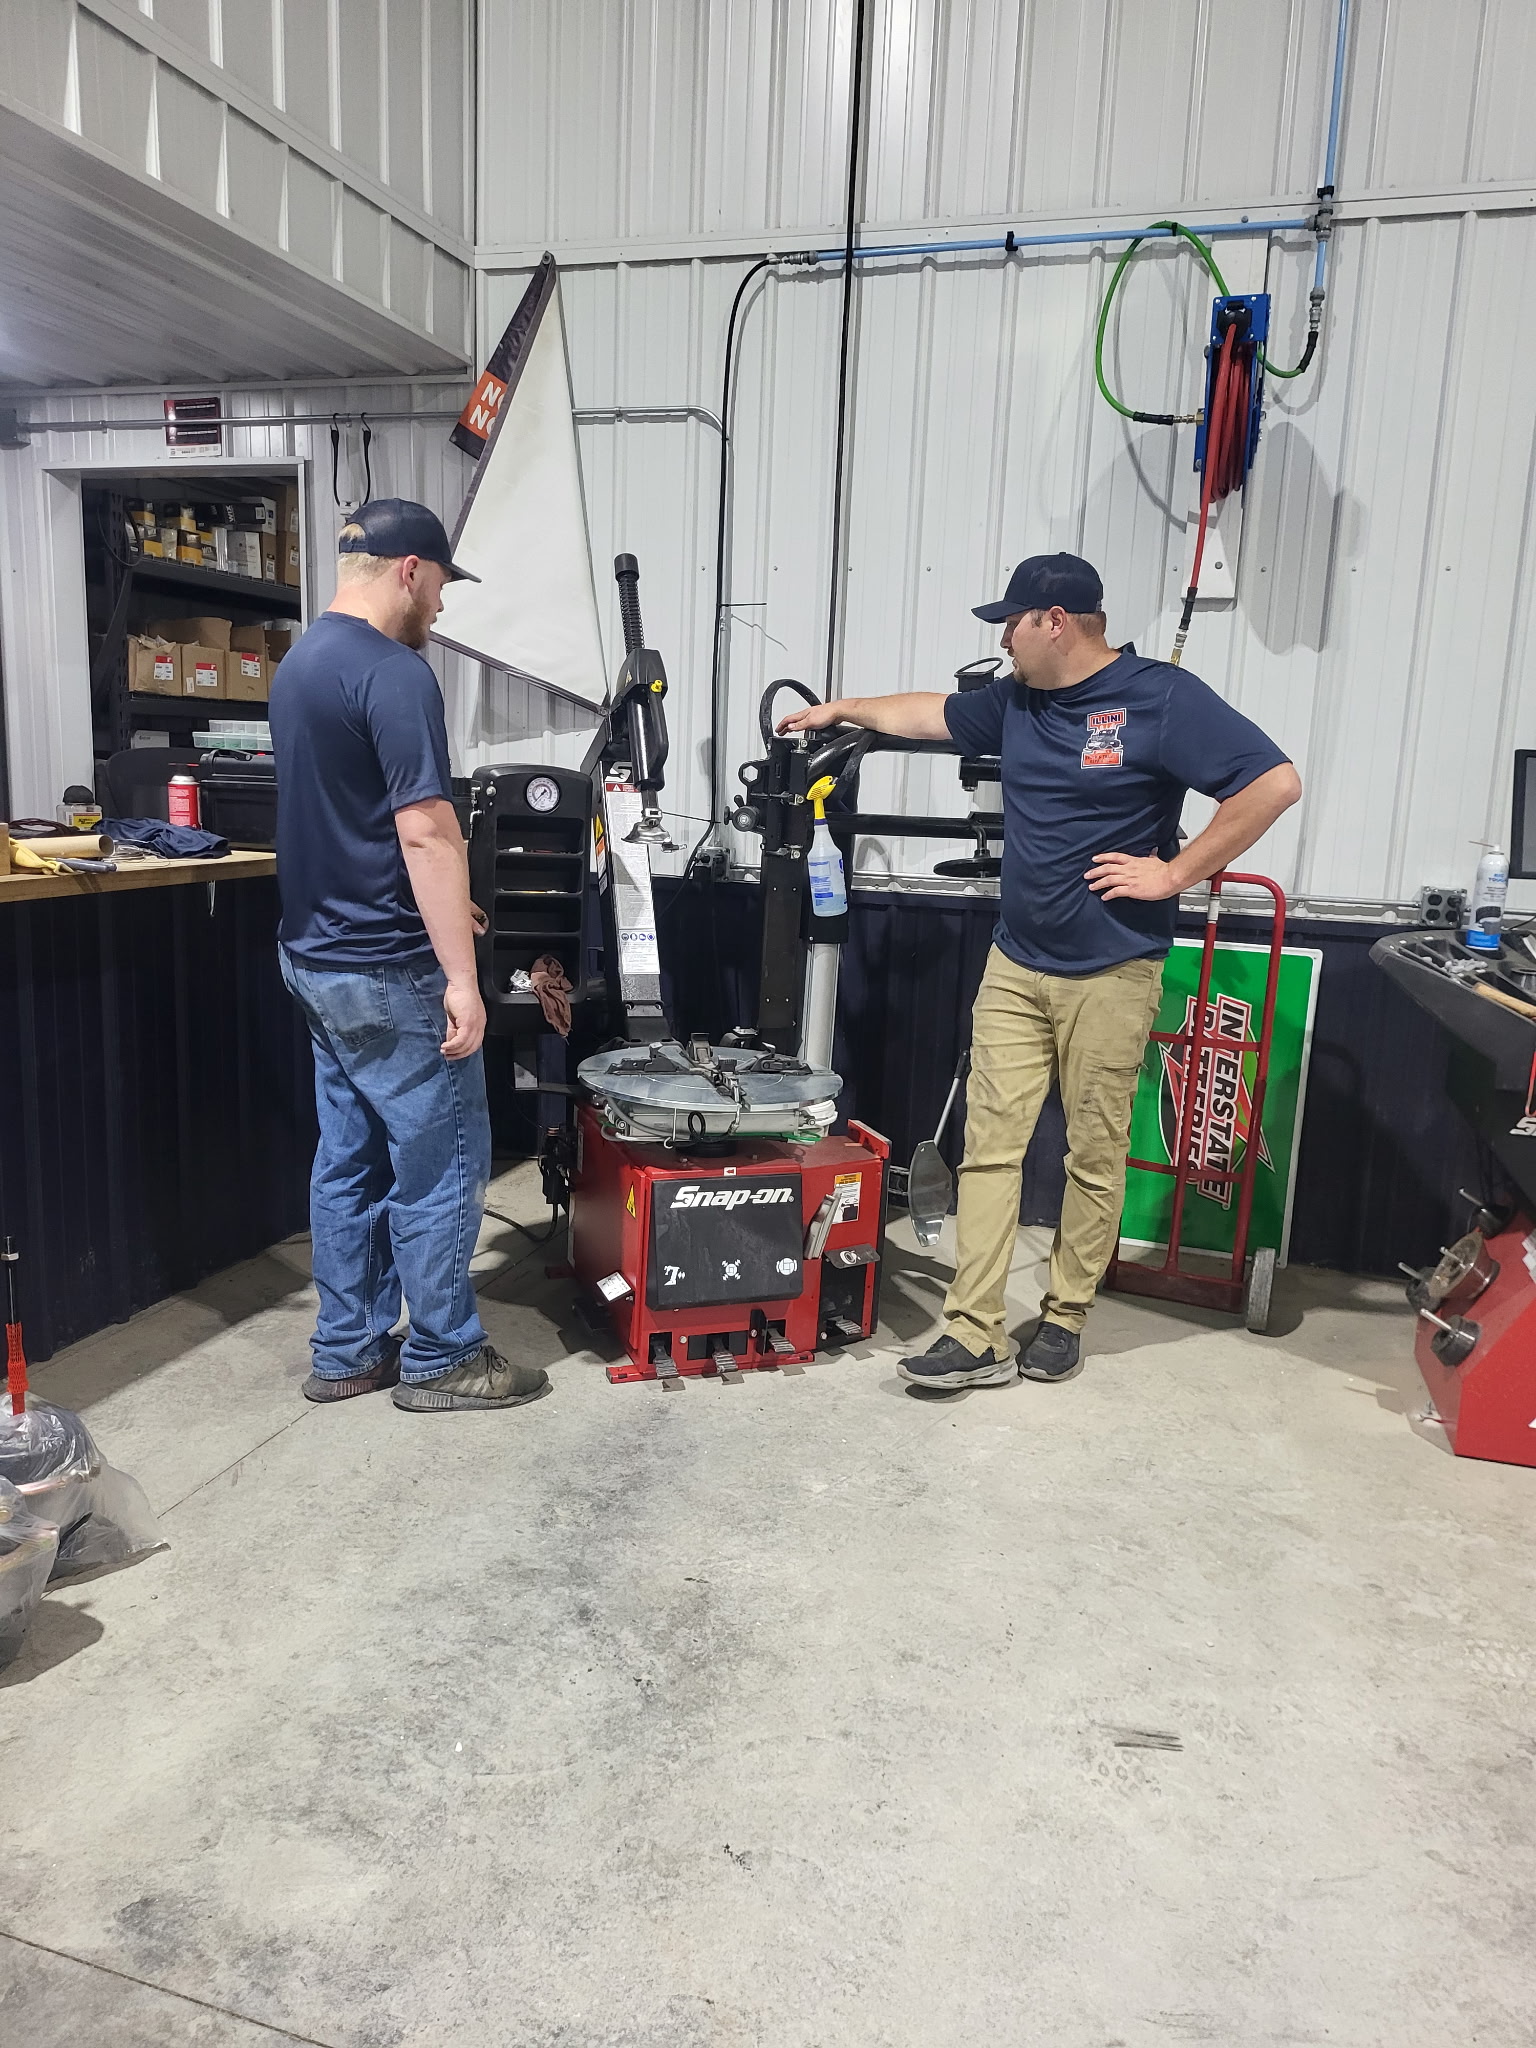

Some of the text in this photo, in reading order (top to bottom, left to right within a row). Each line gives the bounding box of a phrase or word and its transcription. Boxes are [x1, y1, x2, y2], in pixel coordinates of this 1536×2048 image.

[1093, 713, 1121, 725] ILLINI
[1177, 1003, 1216, 1180] BTTERIE
[669, 1185, 794, 1211] Snap-on
